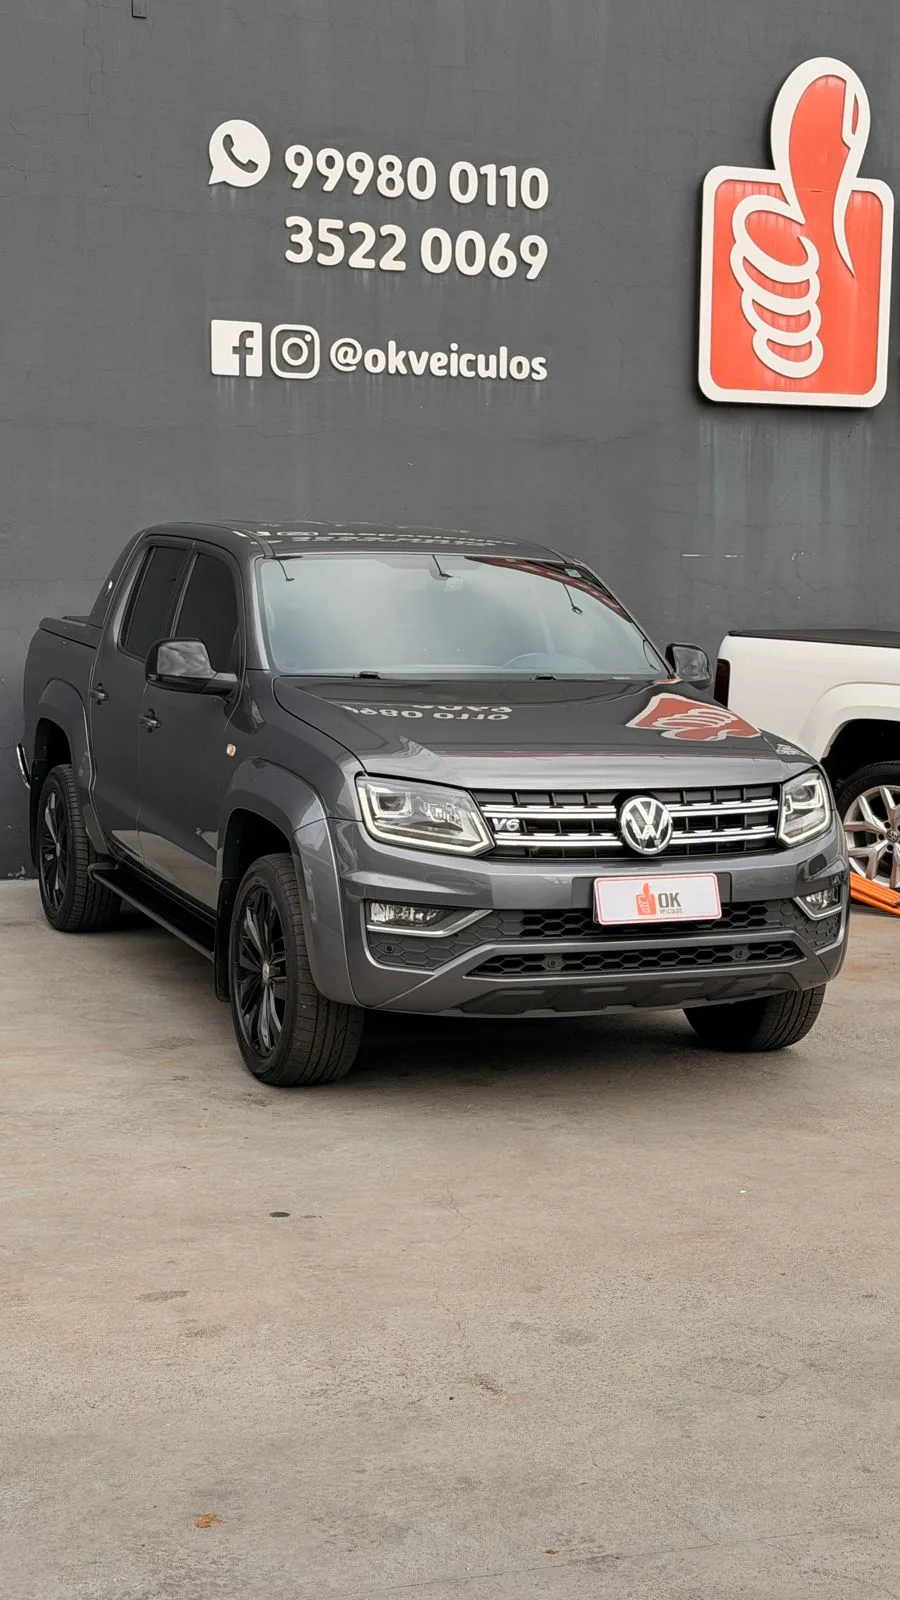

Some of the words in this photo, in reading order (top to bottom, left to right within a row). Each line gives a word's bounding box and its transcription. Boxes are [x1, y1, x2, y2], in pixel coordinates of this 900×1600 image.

[284, 144, 437, 201] 99980
[449, 161, 549, 210] 0110
[284, 215, 407, 272] 3522
[420, 227, 549, 280] 0069
[329, 337, 549, 381] @okveiculos
[492, 818, 520, 832] V6
[657, 891, 682, 908] OK
